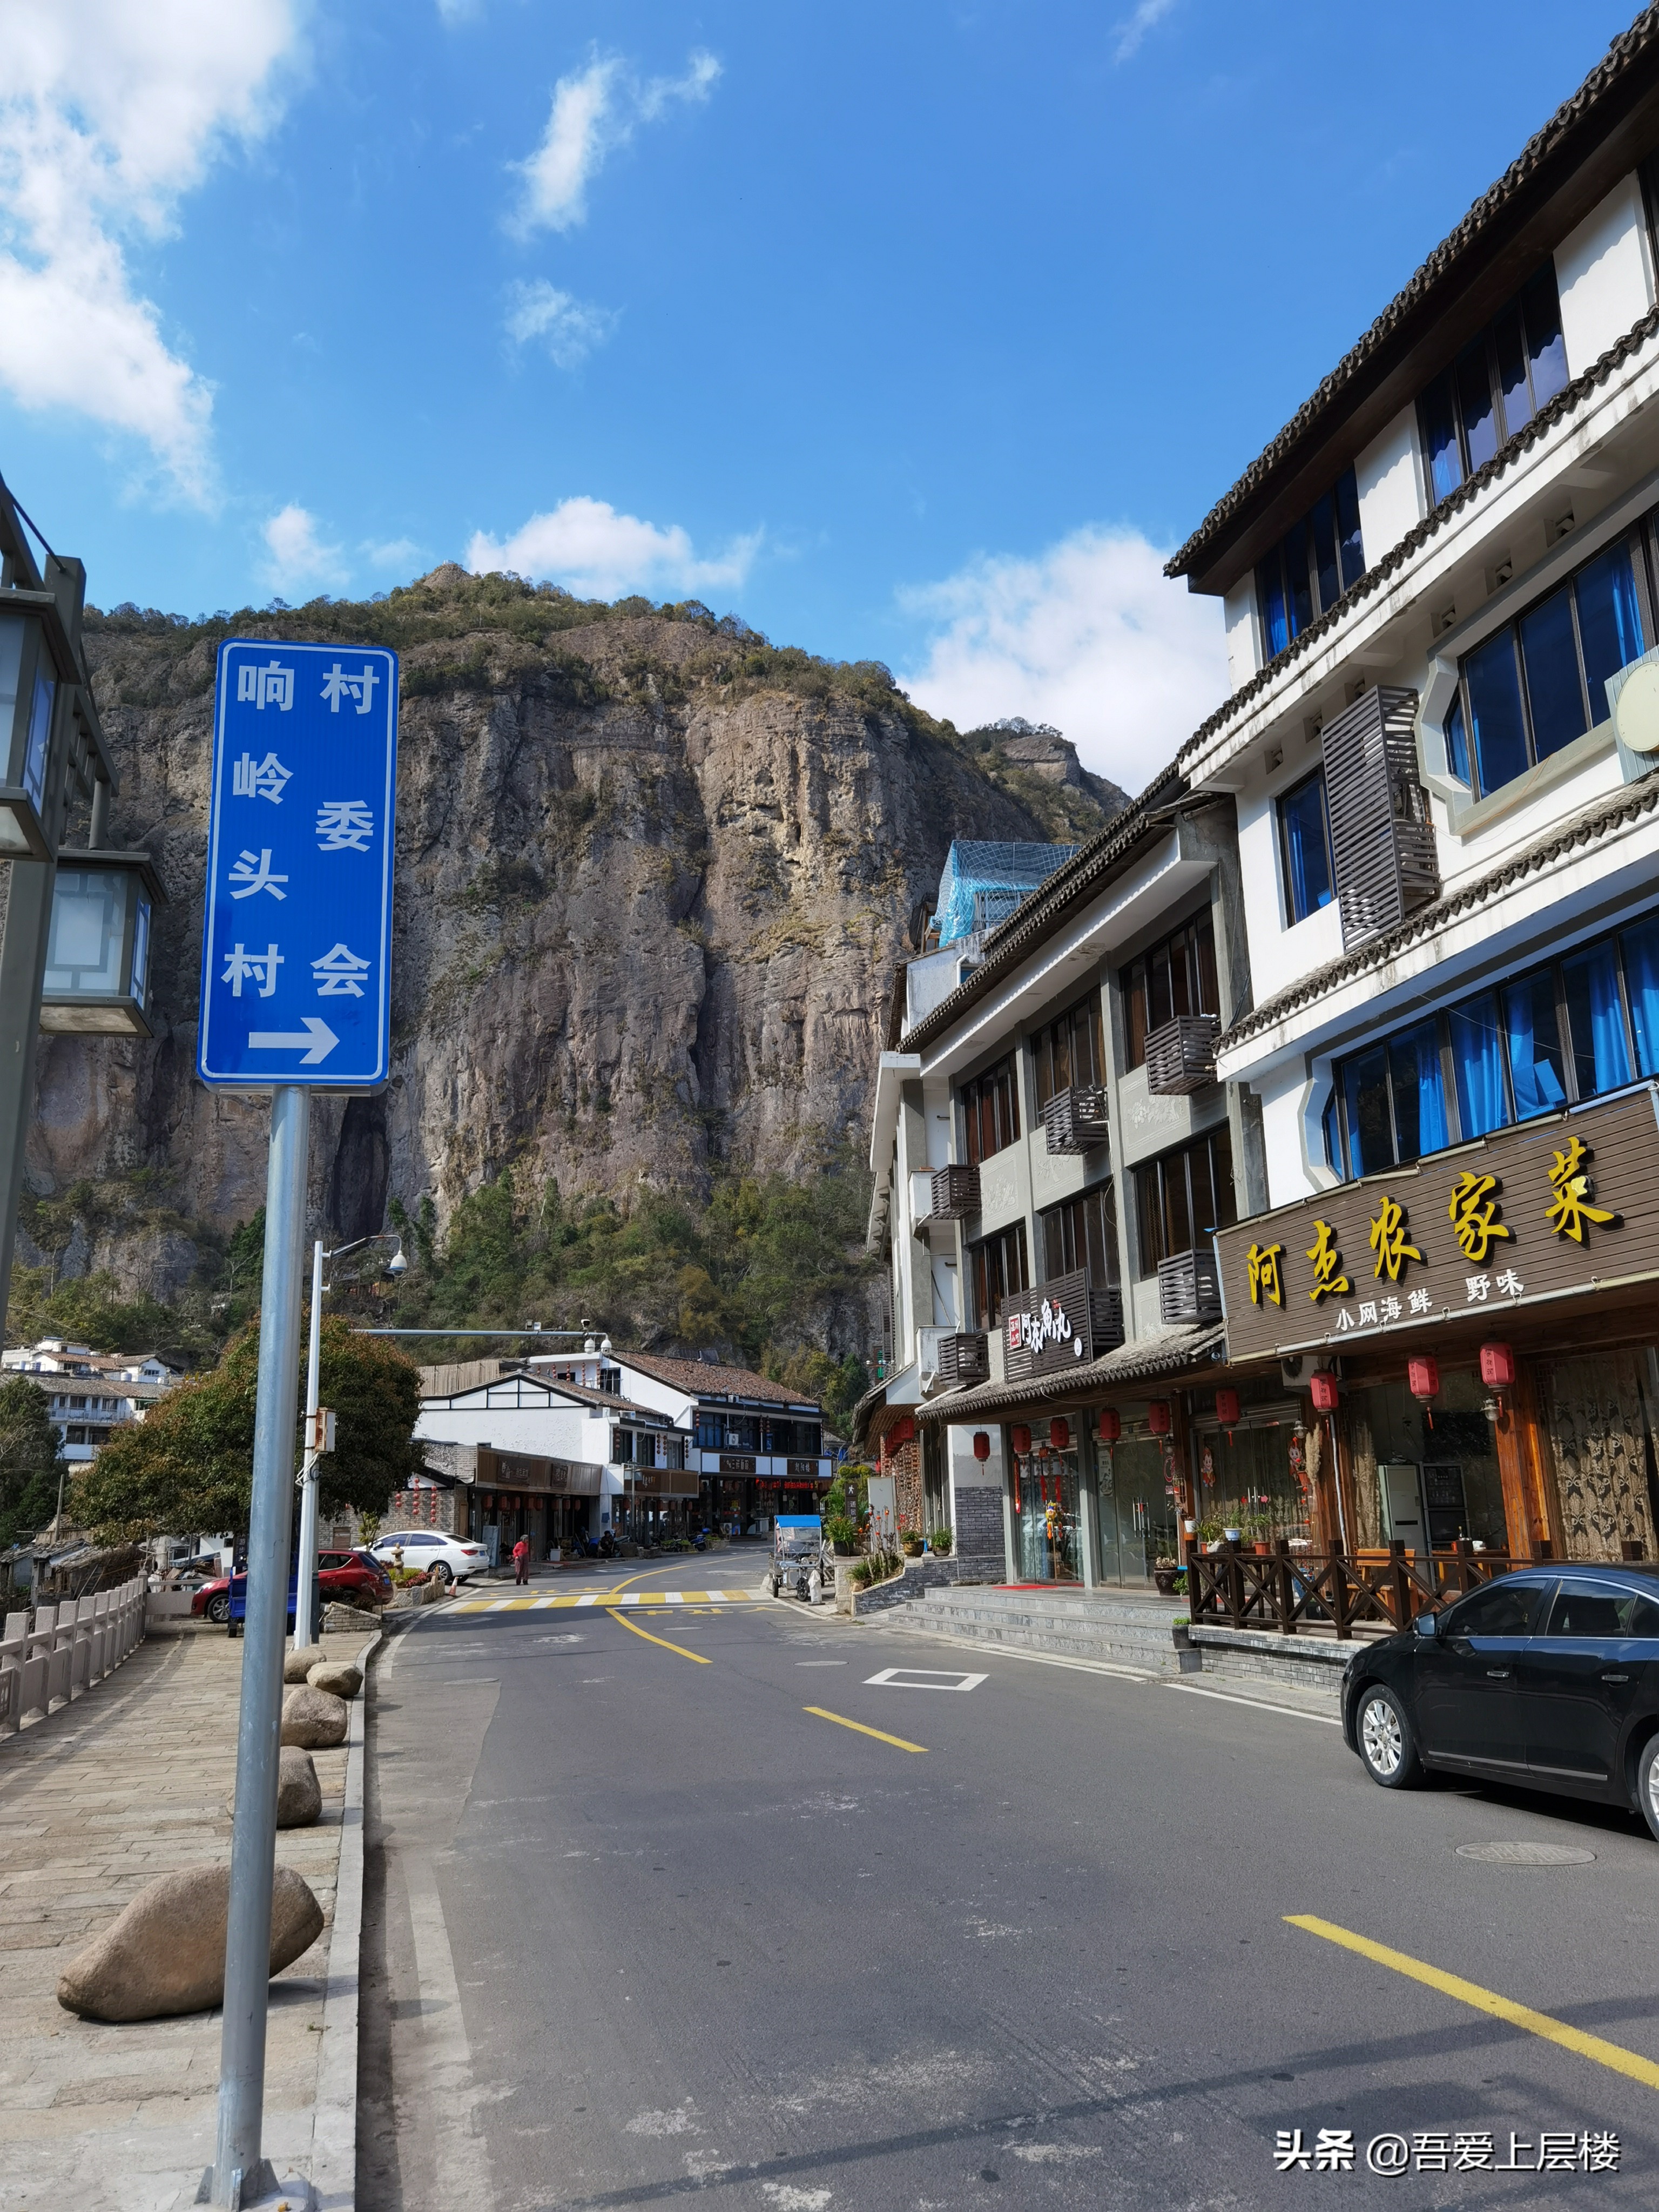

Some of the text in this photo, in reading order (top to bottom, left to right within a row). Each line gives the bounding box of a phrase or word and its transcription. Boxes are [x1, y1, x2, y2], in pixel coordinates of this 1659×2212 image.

[221, 660, 294, 998] 响岭头村
[310, 663, 380, 998] 村委会
[1246, 1136, 1615, 1306] 阿杰农家菜
[1336, 1269, 1525, 1331] 小网海鲜 野味
